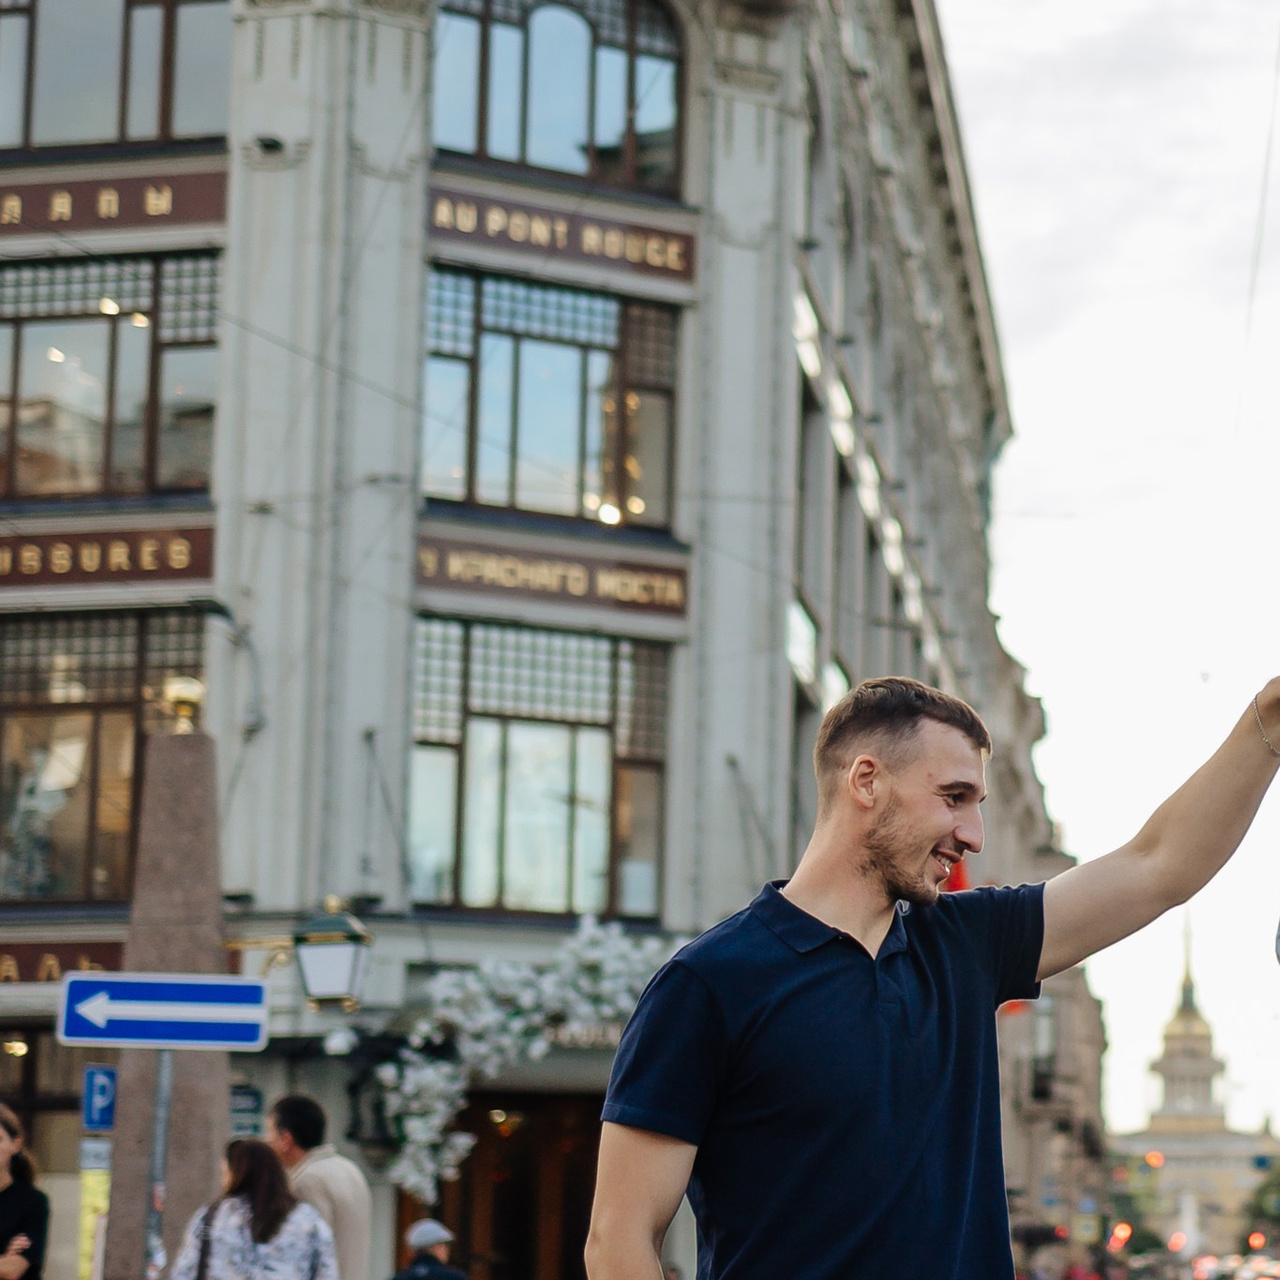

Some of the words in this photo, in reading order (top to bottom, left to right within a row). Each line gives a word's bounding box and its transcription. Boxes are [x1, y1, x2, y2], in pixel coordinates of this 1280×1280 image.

[434, 198, 478, 233] AU
[486, 205, 568, 250] PONT
[581, 225, 687, 271] ROUGE
[596, 567, 684, 608] МОСТА
[93, 1073, 115, 1121] P
